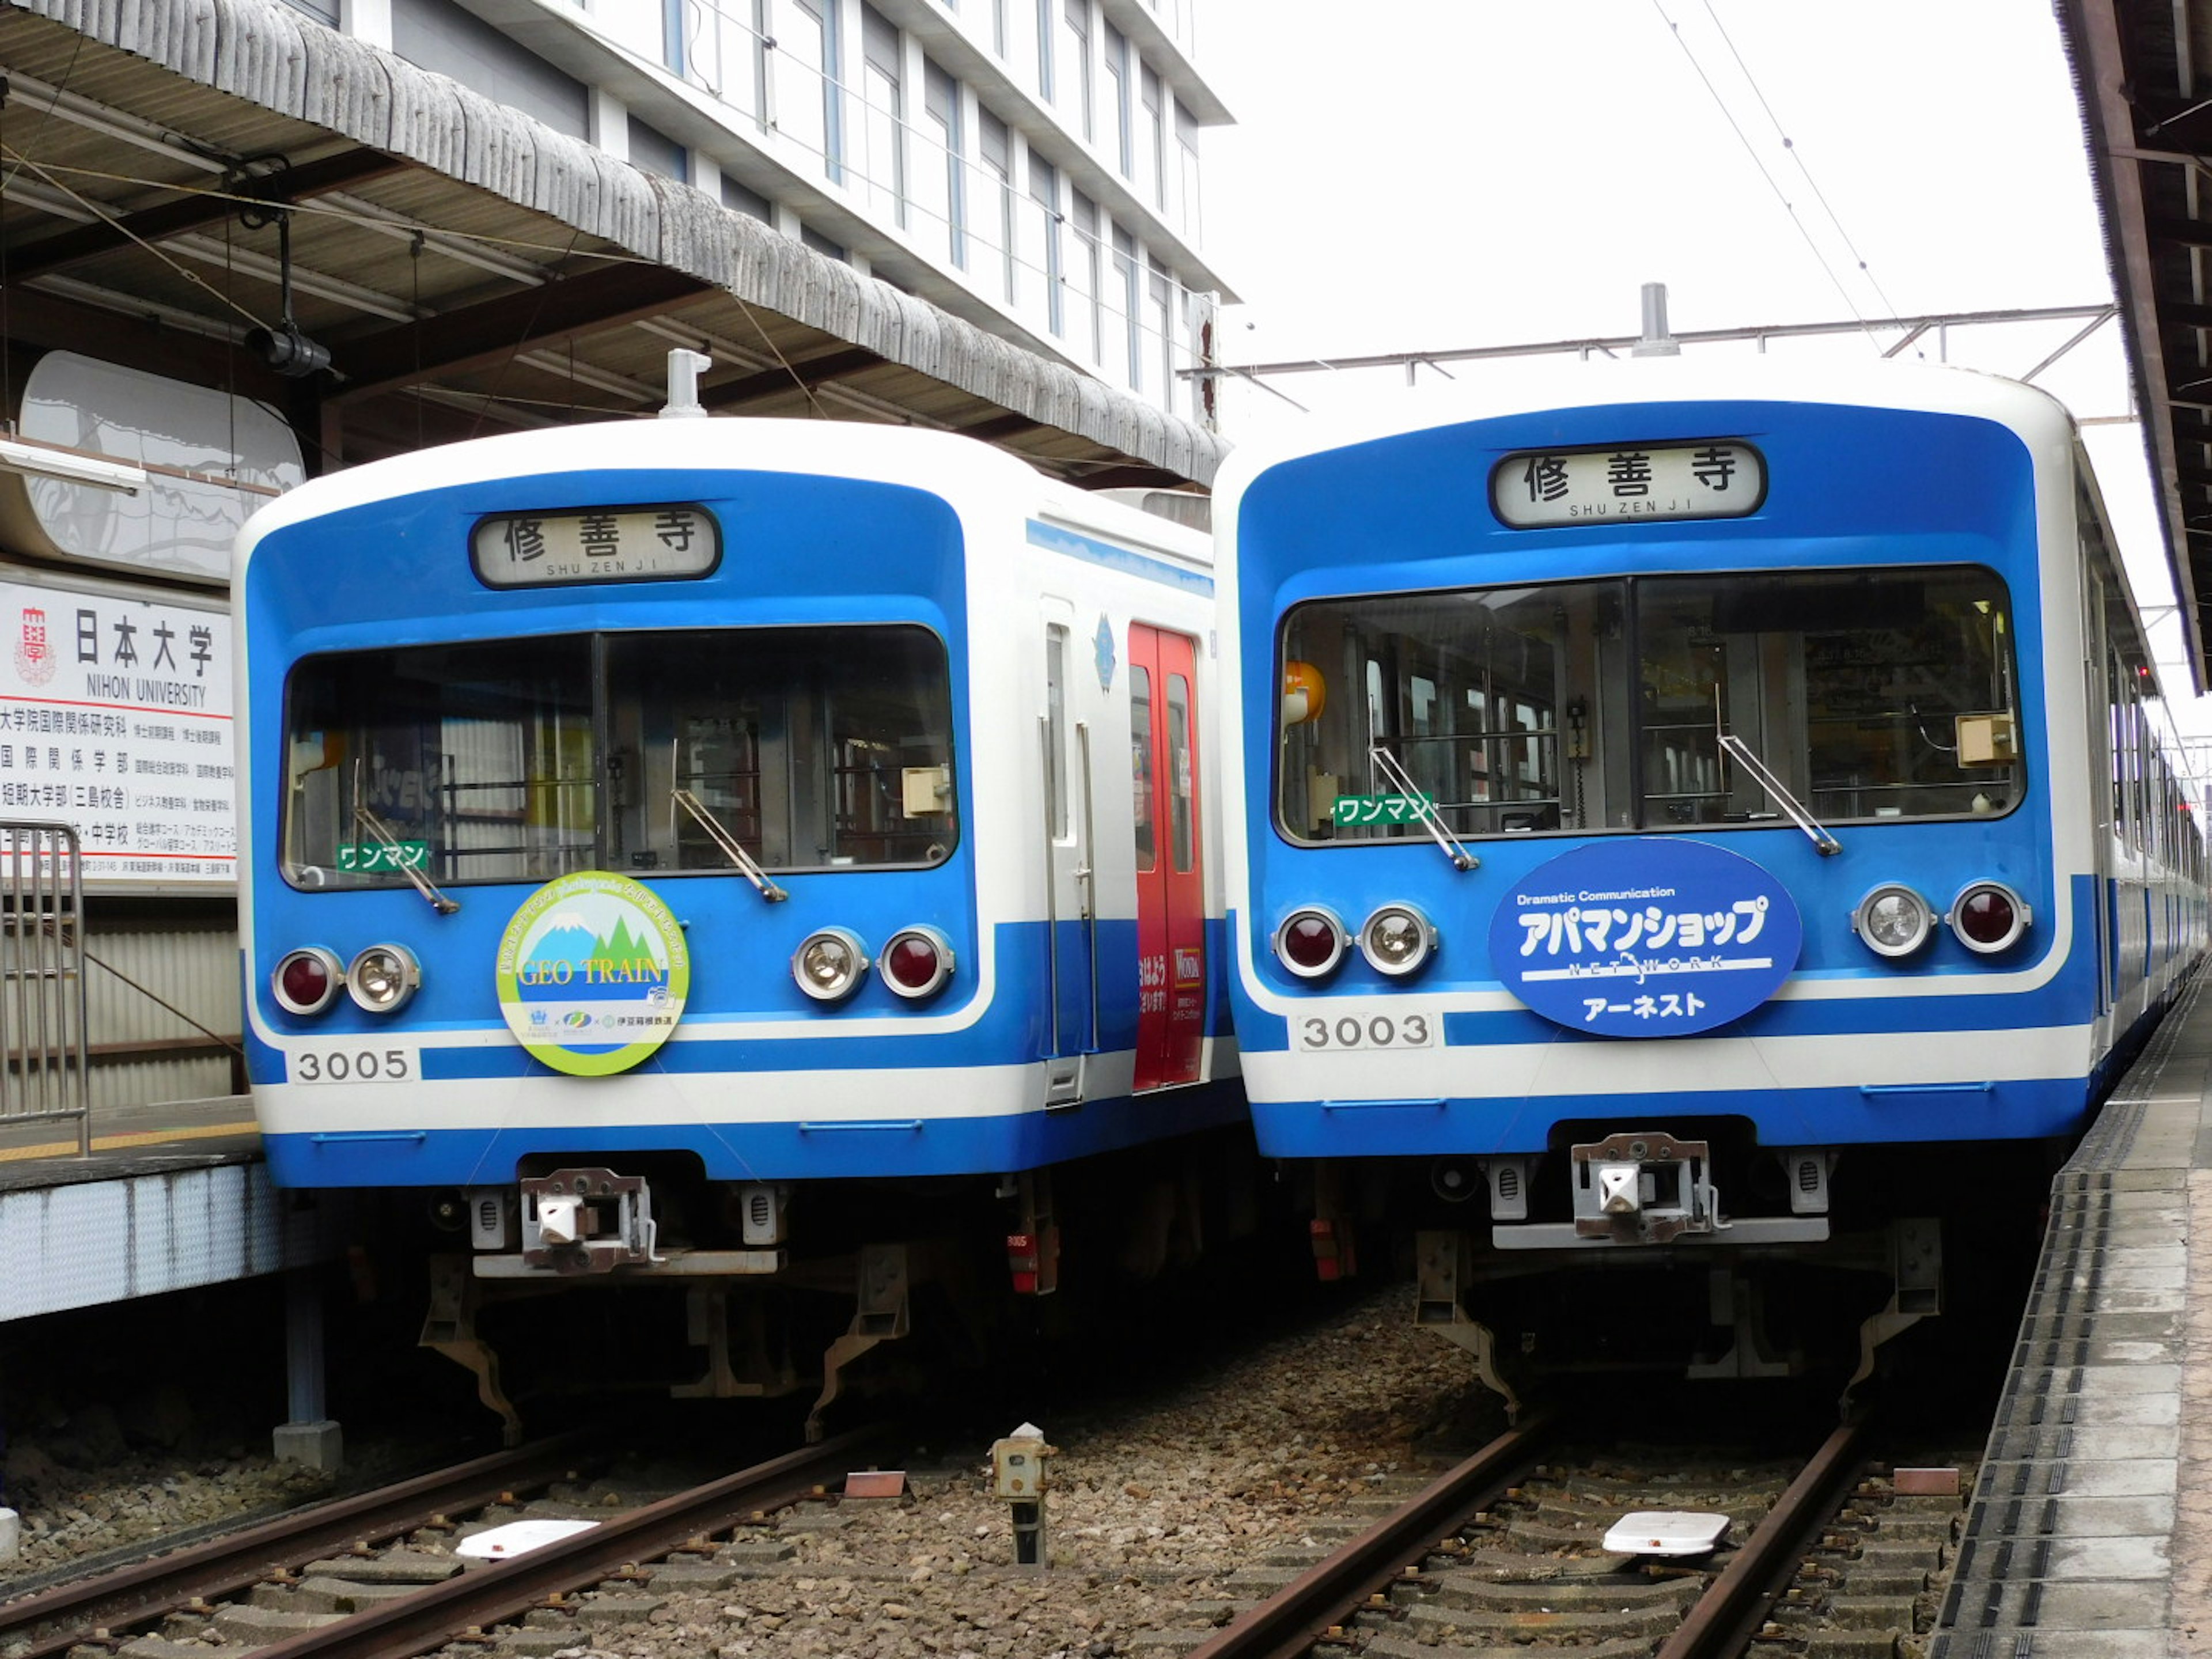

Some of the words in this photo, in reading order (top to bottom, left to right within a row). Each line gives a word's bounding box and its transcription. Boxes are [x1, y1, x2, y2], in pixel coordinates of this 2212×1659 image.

[1524, 447, 1735, 502] 修善寺
[504, 511, 694, 562] 修善寺
[77, 608, 213, 677] 日本大学
[87, 673, 130, 700] NIHON
[137, 679, 206, 708] UNIVERSITY
[0, 709, 127, 738] 大学院国際関係研究科
[2, 744, 128, 774] 国際関係学部
[1339, 798, 1431, 823] ワンマン
[341, 846, 423, 869] ワンマン
[1517, 892, 1575, 906] Dramatic
[1578, 886, 1676, 903] Communication
[1518, 895, 1770, 957] アパマンショップ
[519, 960, 573, 985] GEO
[580, 958, 662, 984] TRAIN
[1570, 955, 1722, 976] NETWORK
[1582, 993, 1706, 1022] アーネスト
[1304, 1014, 1428, 1048] 3003
[299, 1050, 408, 1081] 3005
